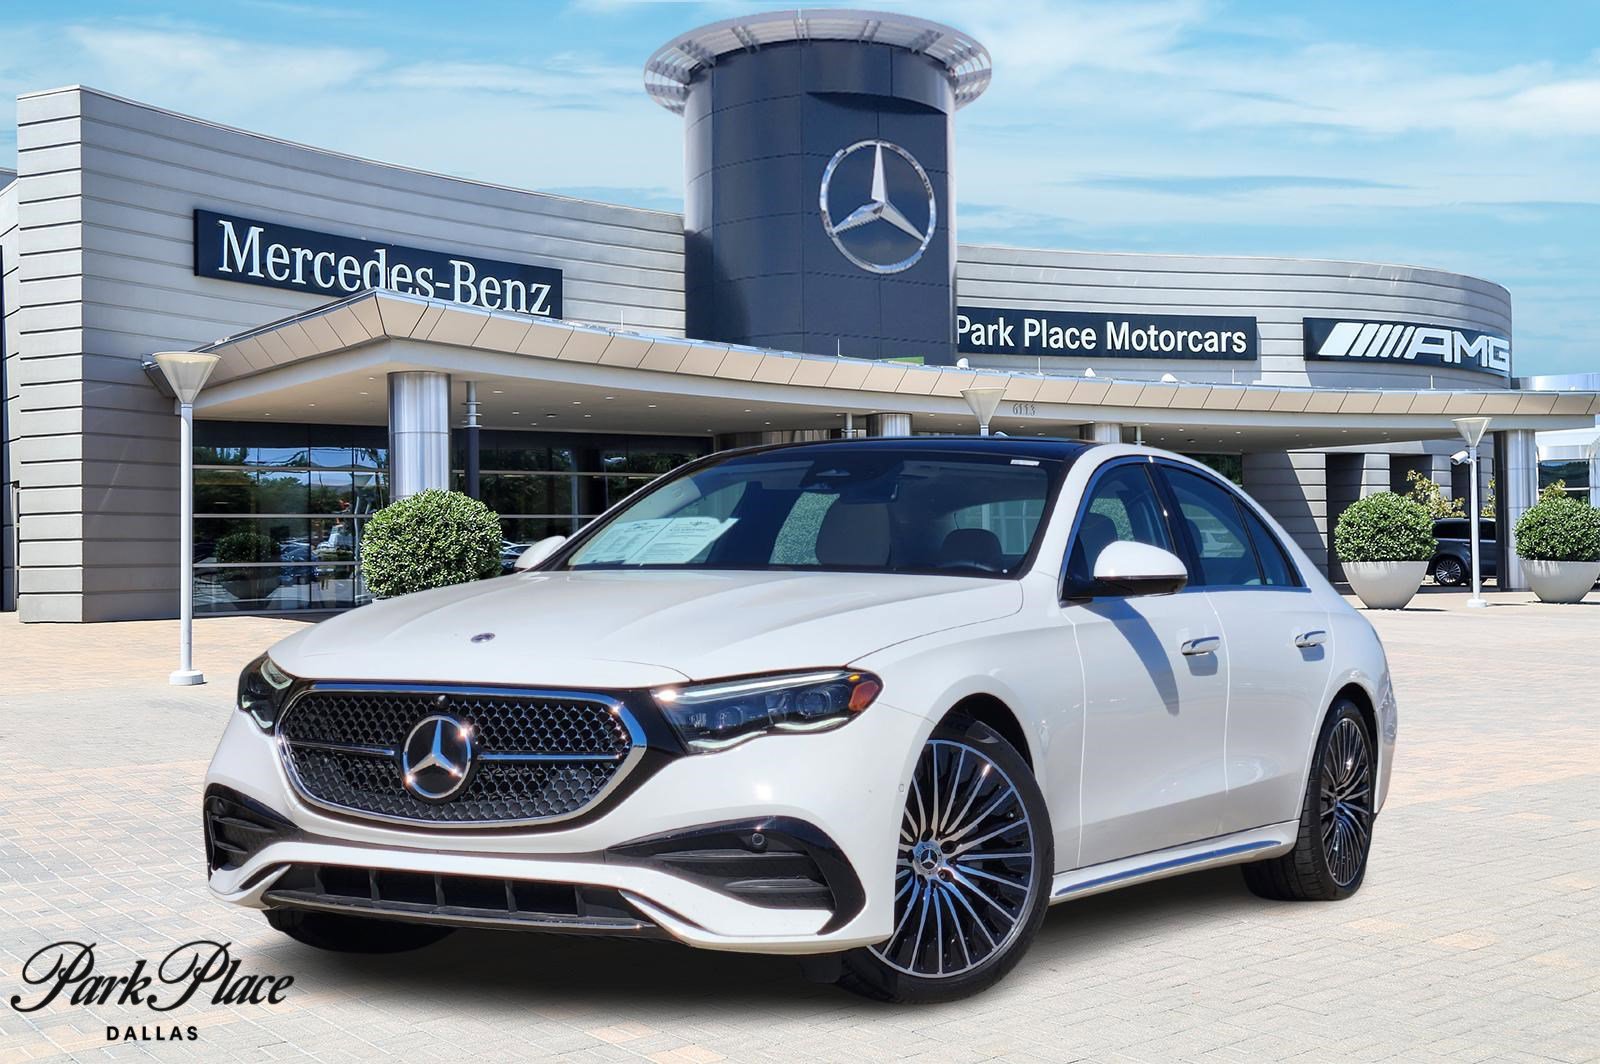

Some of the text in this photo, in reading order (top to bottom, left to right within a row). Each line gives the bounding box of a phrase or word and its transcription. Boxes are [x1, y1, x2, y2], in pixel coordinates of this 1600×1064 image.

[217, 219, 552, 316] Mercedes-Benz
[957, 315, 1248, 353] Park Place Motorcars
[1403, 326, 1510, 371] AMG
[1012, 402, 1036, 417] 6113
